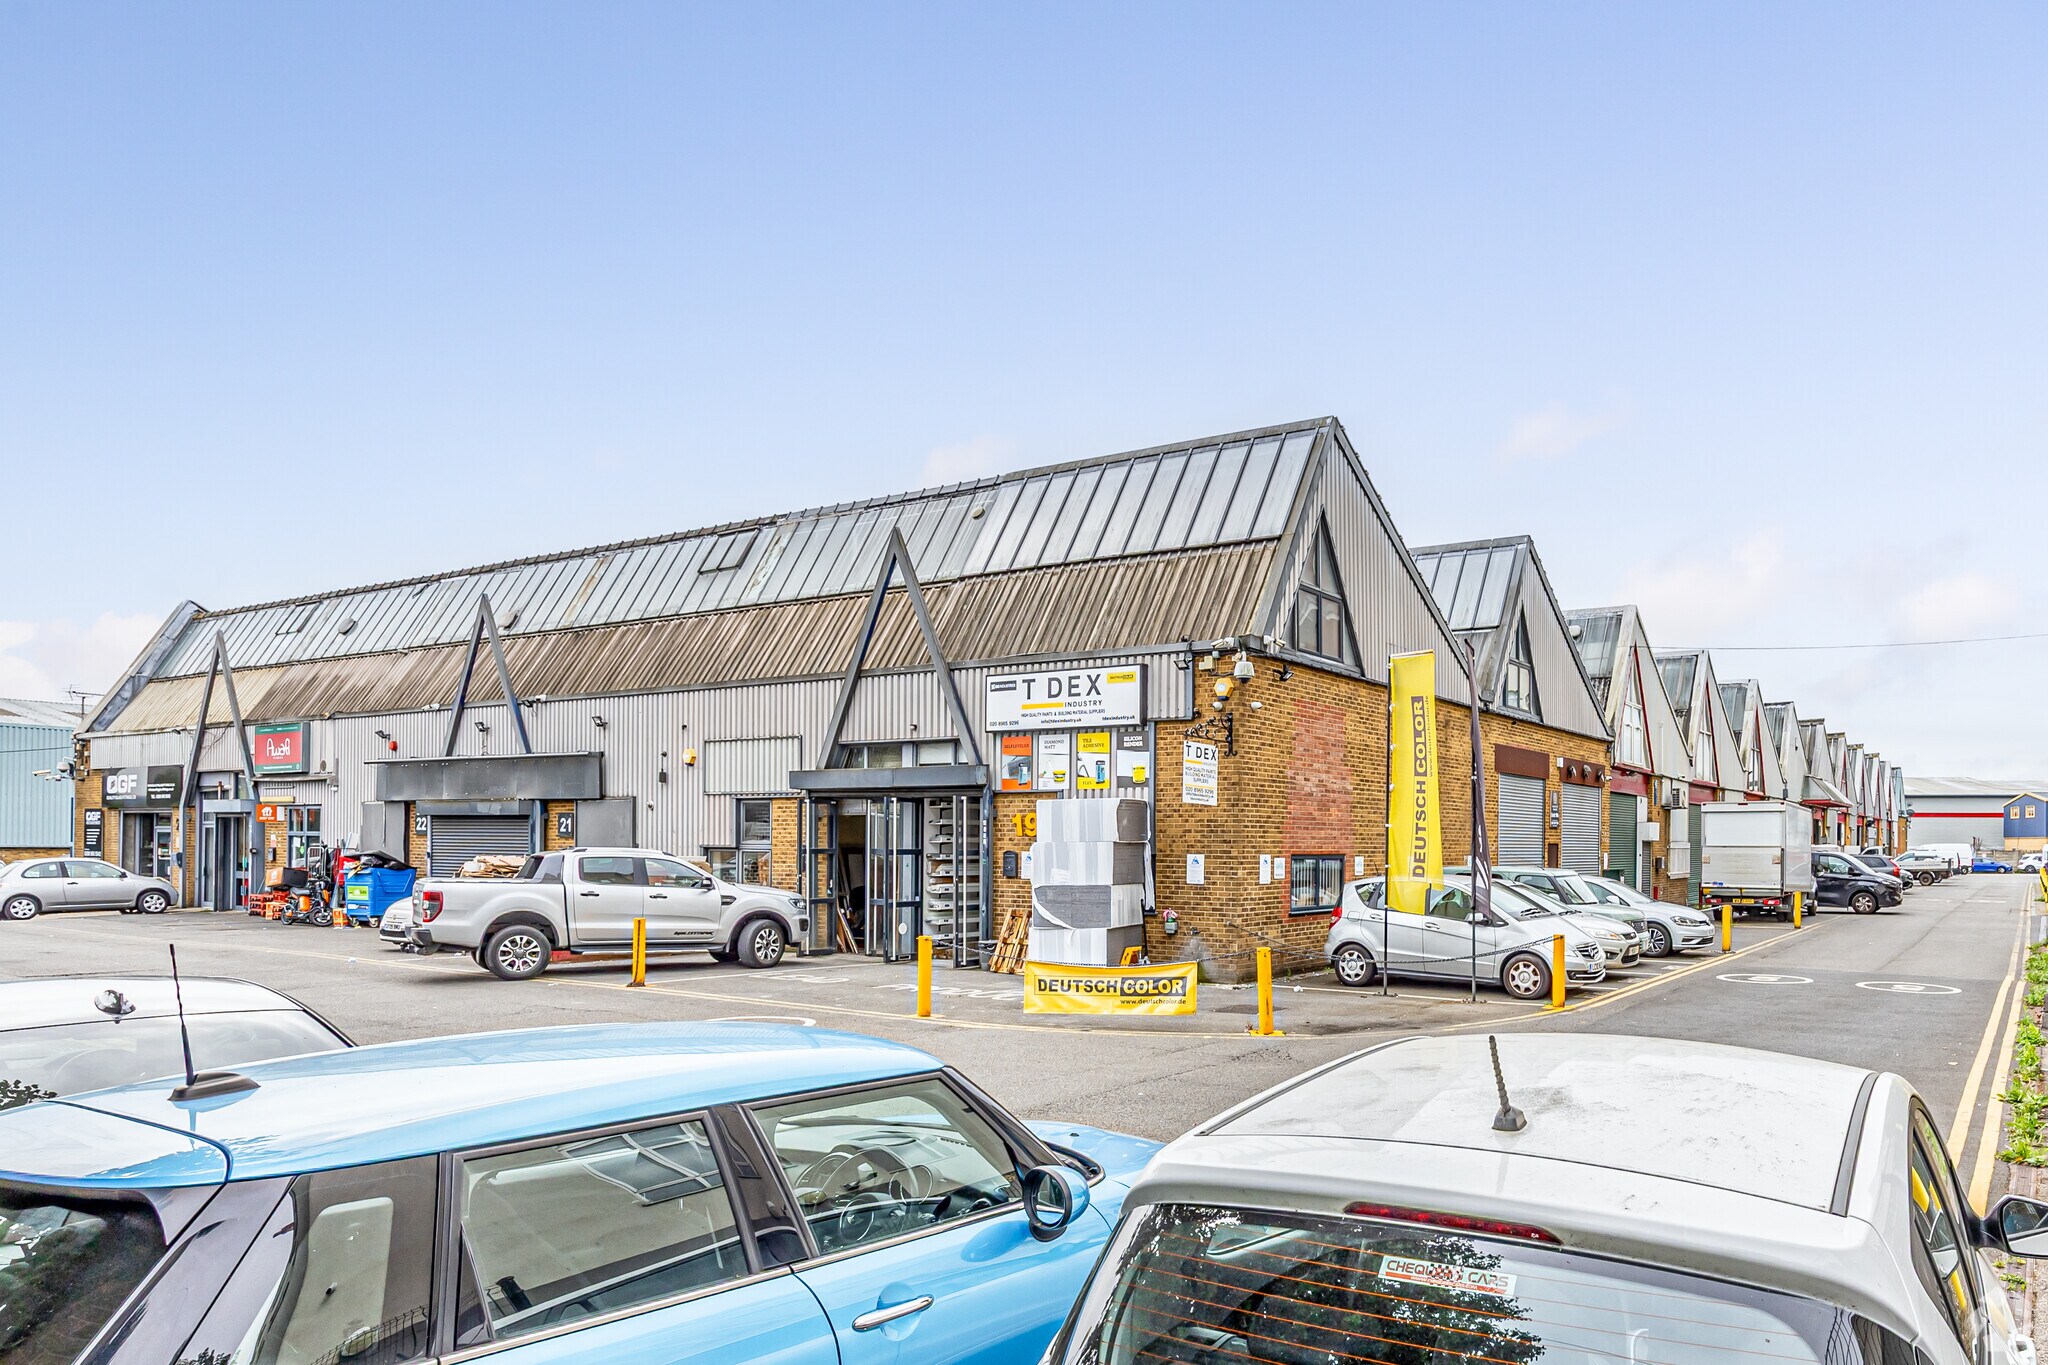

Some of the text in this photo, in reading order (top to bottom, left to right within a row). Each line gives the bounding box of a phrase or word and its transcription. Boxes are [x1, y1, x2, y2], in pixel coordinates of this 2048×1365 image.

[1022, 674, 1102, 700] T DEX
[1064, 699, 1103, 708] INDUSTRY
[1186, 745, 1216, 761] T DEX
[1412, 701, 1427, 879] DEUTSCH COLOR
[416, 817, 427, 831] 22
[560, 817, 572, 832] 21
[1012, 812, 1037, 837] 19
[1037, 977, 1118, 993] DEUTSCH
[1123, 979, 1183, 994] COLOR
[1468, 1271, 1508, 1287] CARS
